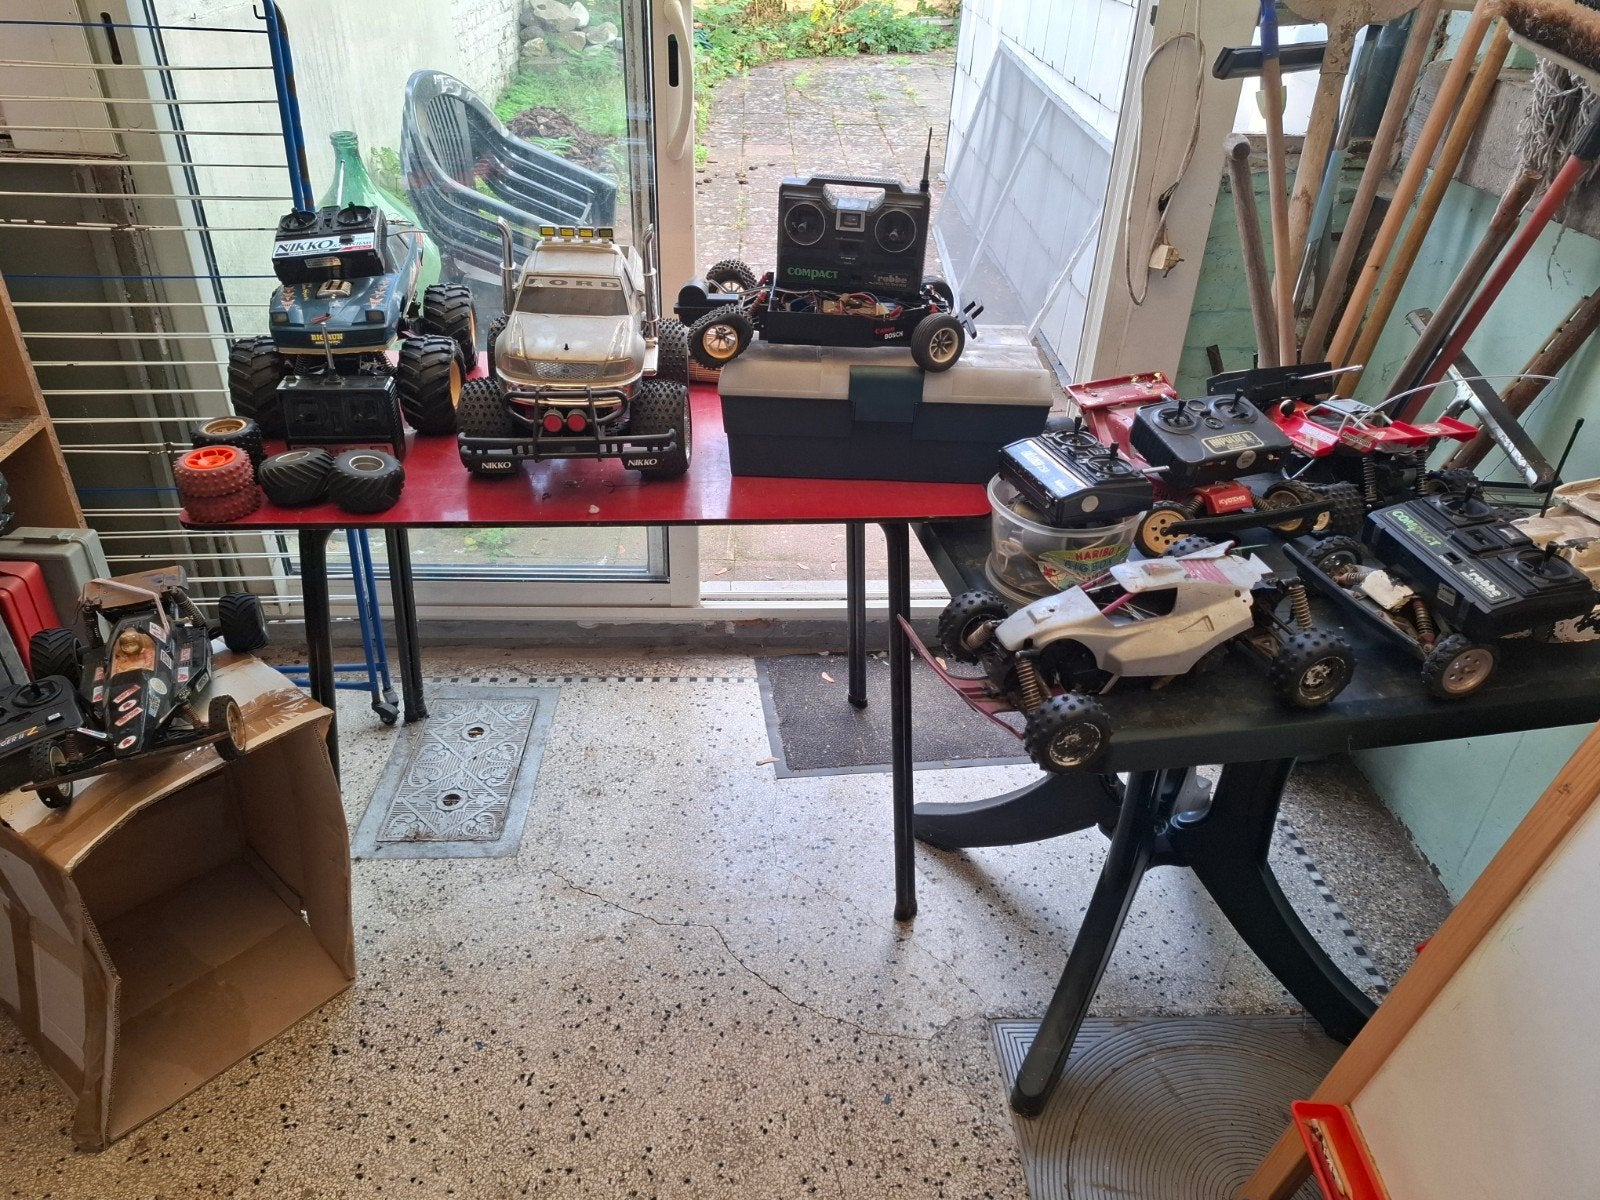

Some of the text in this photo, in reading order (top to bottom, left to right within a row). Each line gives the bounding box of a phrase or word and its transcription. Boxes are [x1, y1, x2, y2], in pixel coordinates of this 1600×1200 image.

[275, 240, 333, 253] NIKKO
[787, 267, 839, 279] COMPACT
[528, 278, 620, 288] FORD
[884, 331, 904, 340] BOSCH
[481, 461, 512, 470] NIKKO
[628, 458, 658, 467] NIKKO
[1218, 495, 1246, 506] KYOSHO
[1392, 509, 1441, 547] COMPACT
[1075, 547, 1115, 561] HARIBO
